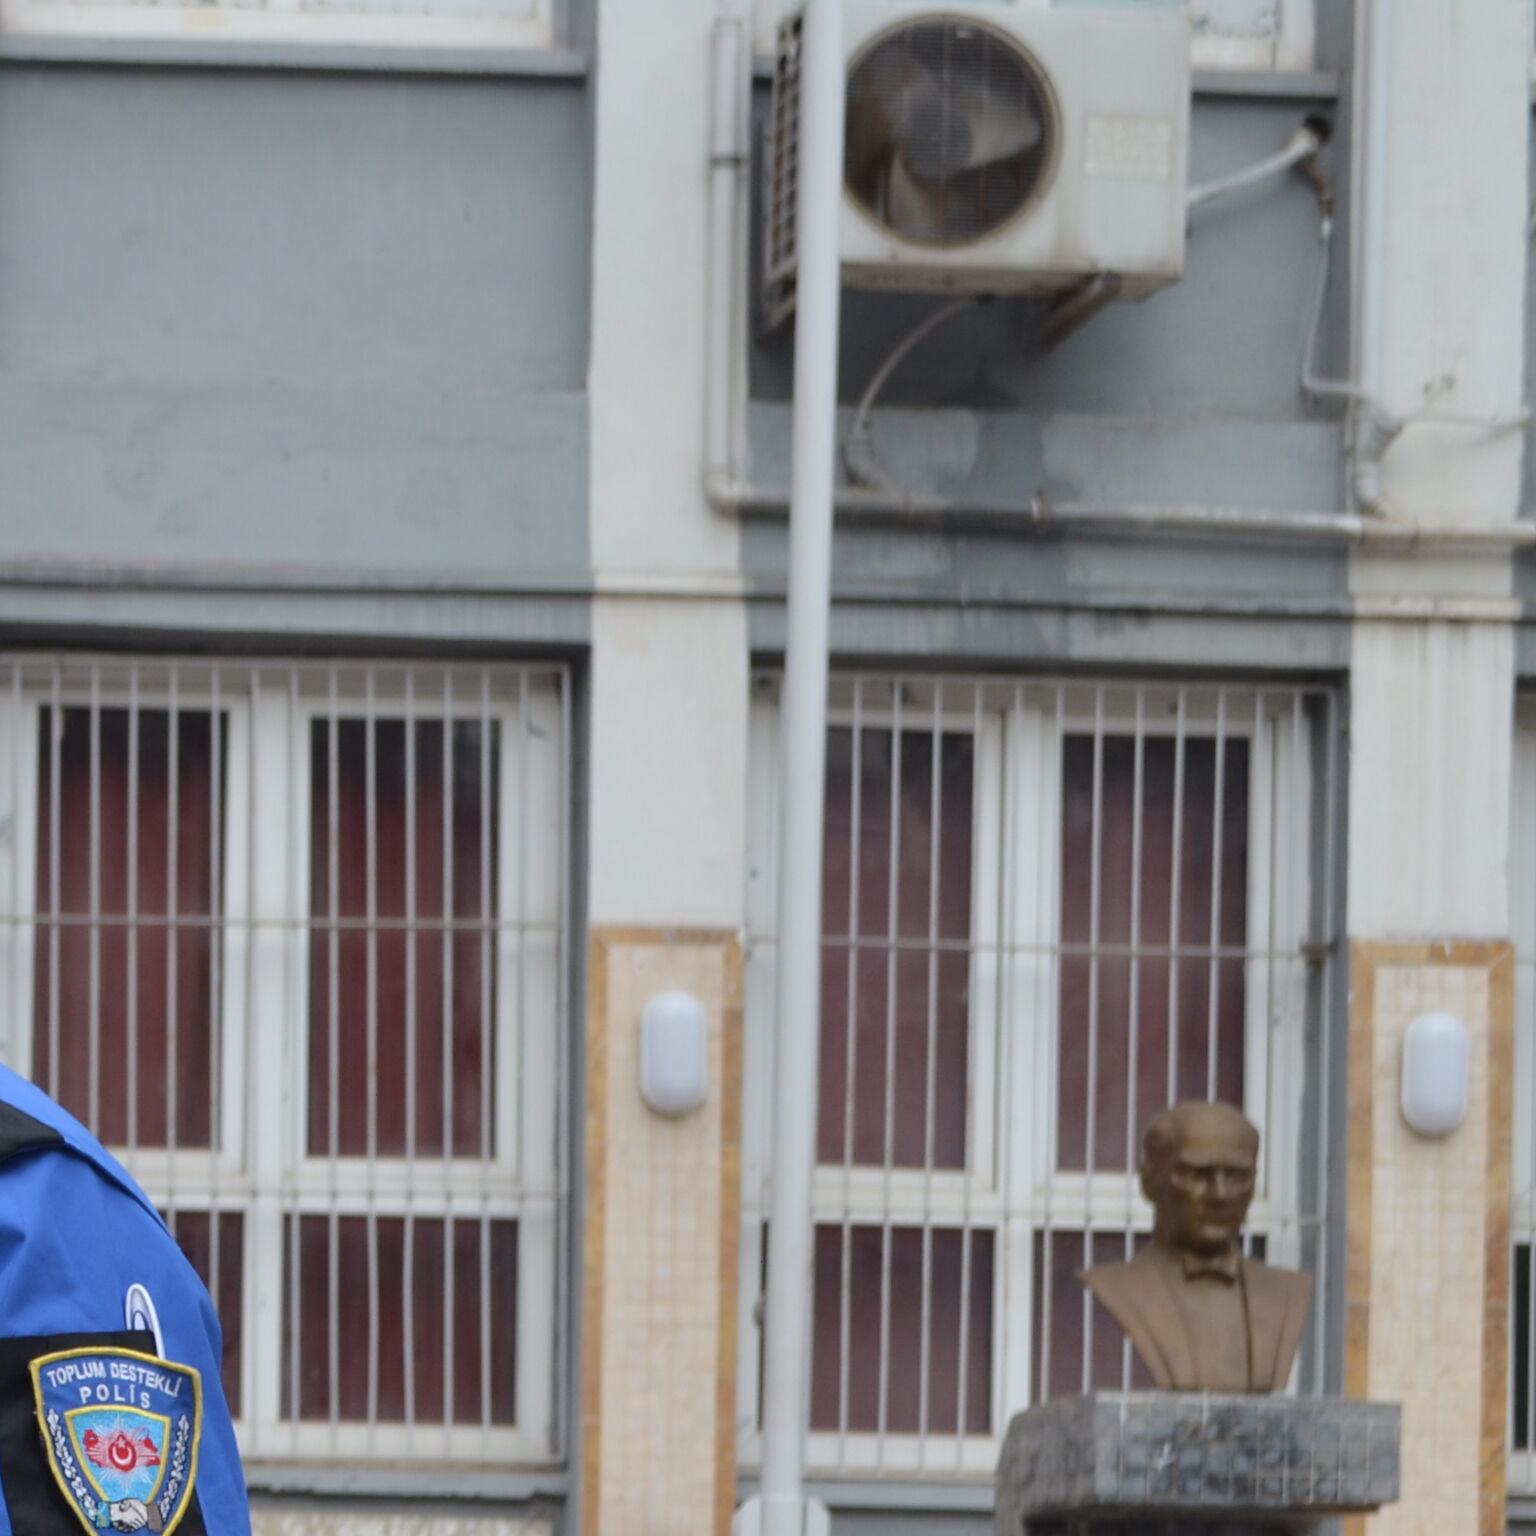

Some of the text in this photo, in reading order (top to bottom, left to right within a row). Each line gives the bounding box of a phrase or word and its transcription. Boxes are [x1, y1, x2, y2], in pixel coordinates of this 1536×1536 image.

[46, 1361, 183, 1398] TOPLUM DESTEKLİ
[79, 1384, 151, 1409] POLİS
